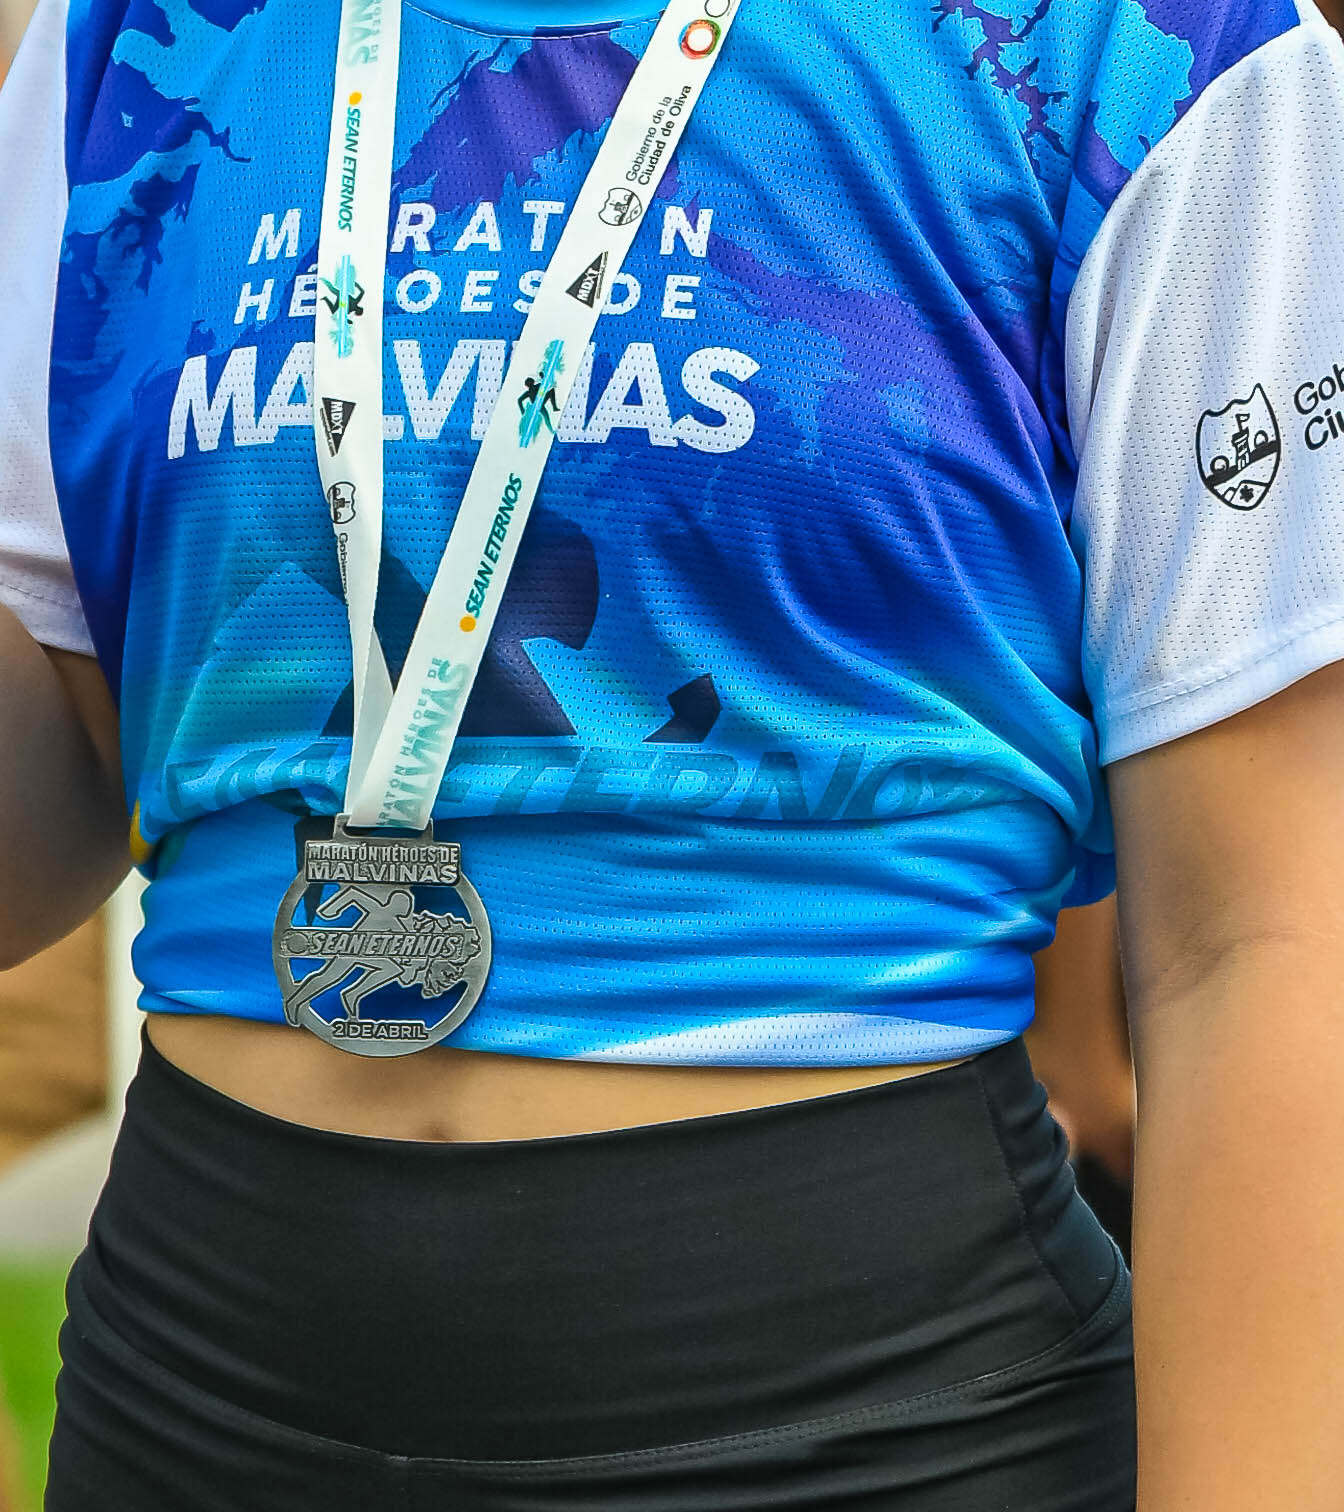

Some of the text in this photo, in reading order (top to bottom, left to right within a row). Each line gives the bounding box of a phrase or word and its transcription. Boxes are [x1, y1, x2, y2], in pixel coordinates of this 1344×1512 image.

[625, 95, 673, 182] Gobierno de la
[637, 84, 693, 186] Ciudad de Oliva
[338, 106, 361, 233] SEAN ETERNOS
[247, 201, 714, 266] MRATN
[234, 263, 548, 325] HÉOES
[601, 271, 702, 320] DE
[576, 266, 603, 303] MDXT
[167, 338, 761, 460] MAVIAS
[330, 400, 344, 436] MDXT
[465, 472, 523, 619] SEAN ETERNOS
[426, 656, 444, 679] DE
[307, 861, 459, 884] MALVINAS
[308, 842, 459, 864] MARATÓN HÉROES DE
[310, 932, 459, 958] SEAN ETERNOS
[333, 1022, 428, 1039] 2 DE ABRIL
